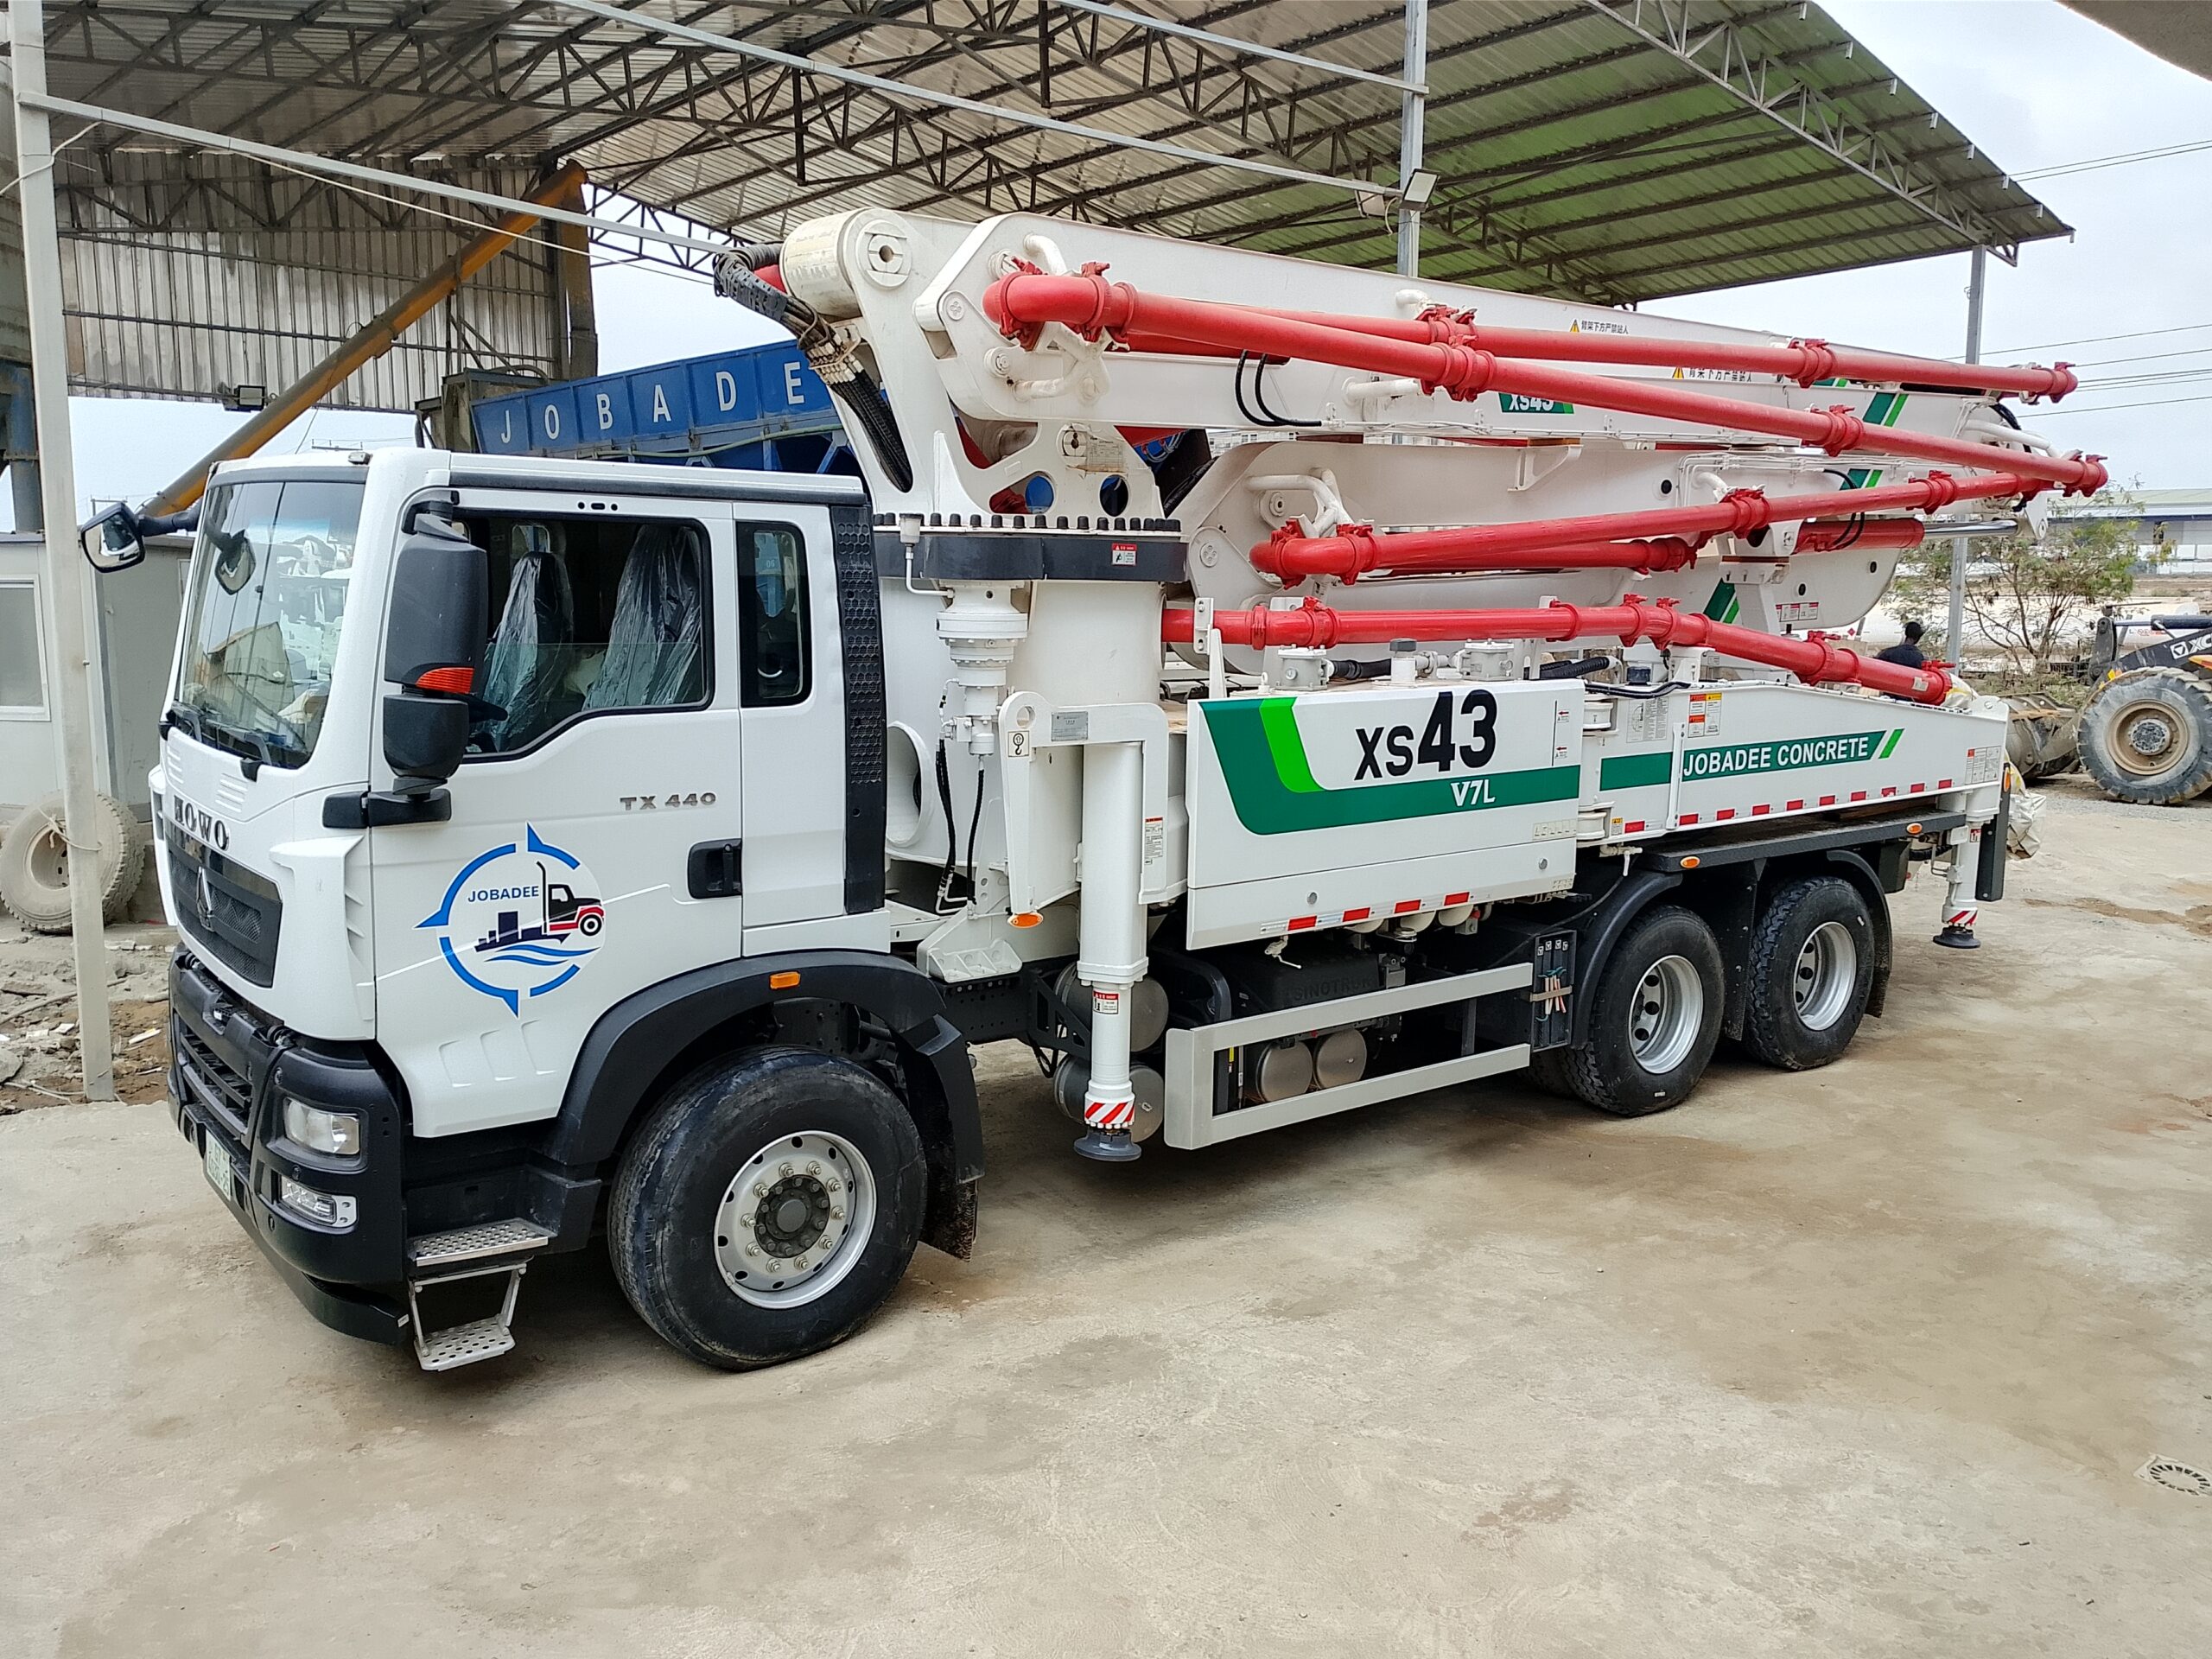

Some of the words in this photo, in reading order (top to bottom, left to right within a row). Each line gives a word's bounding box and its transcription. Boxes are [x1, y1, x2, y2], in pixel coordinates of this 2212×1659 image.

[1354, 689, 1498, 781] XS43
[1683, 746, 1772, 779] JOBADEE
[1777, 735, 1870, 767] CONCRETE
[619, 796, 658, 811] TX
[664, 791, 717, 808] 440
[1450, 778, 1496, 807] V7L
[173, 795, 230, 851] HOWO
[467, 885, 539, 904] JOBADEE
